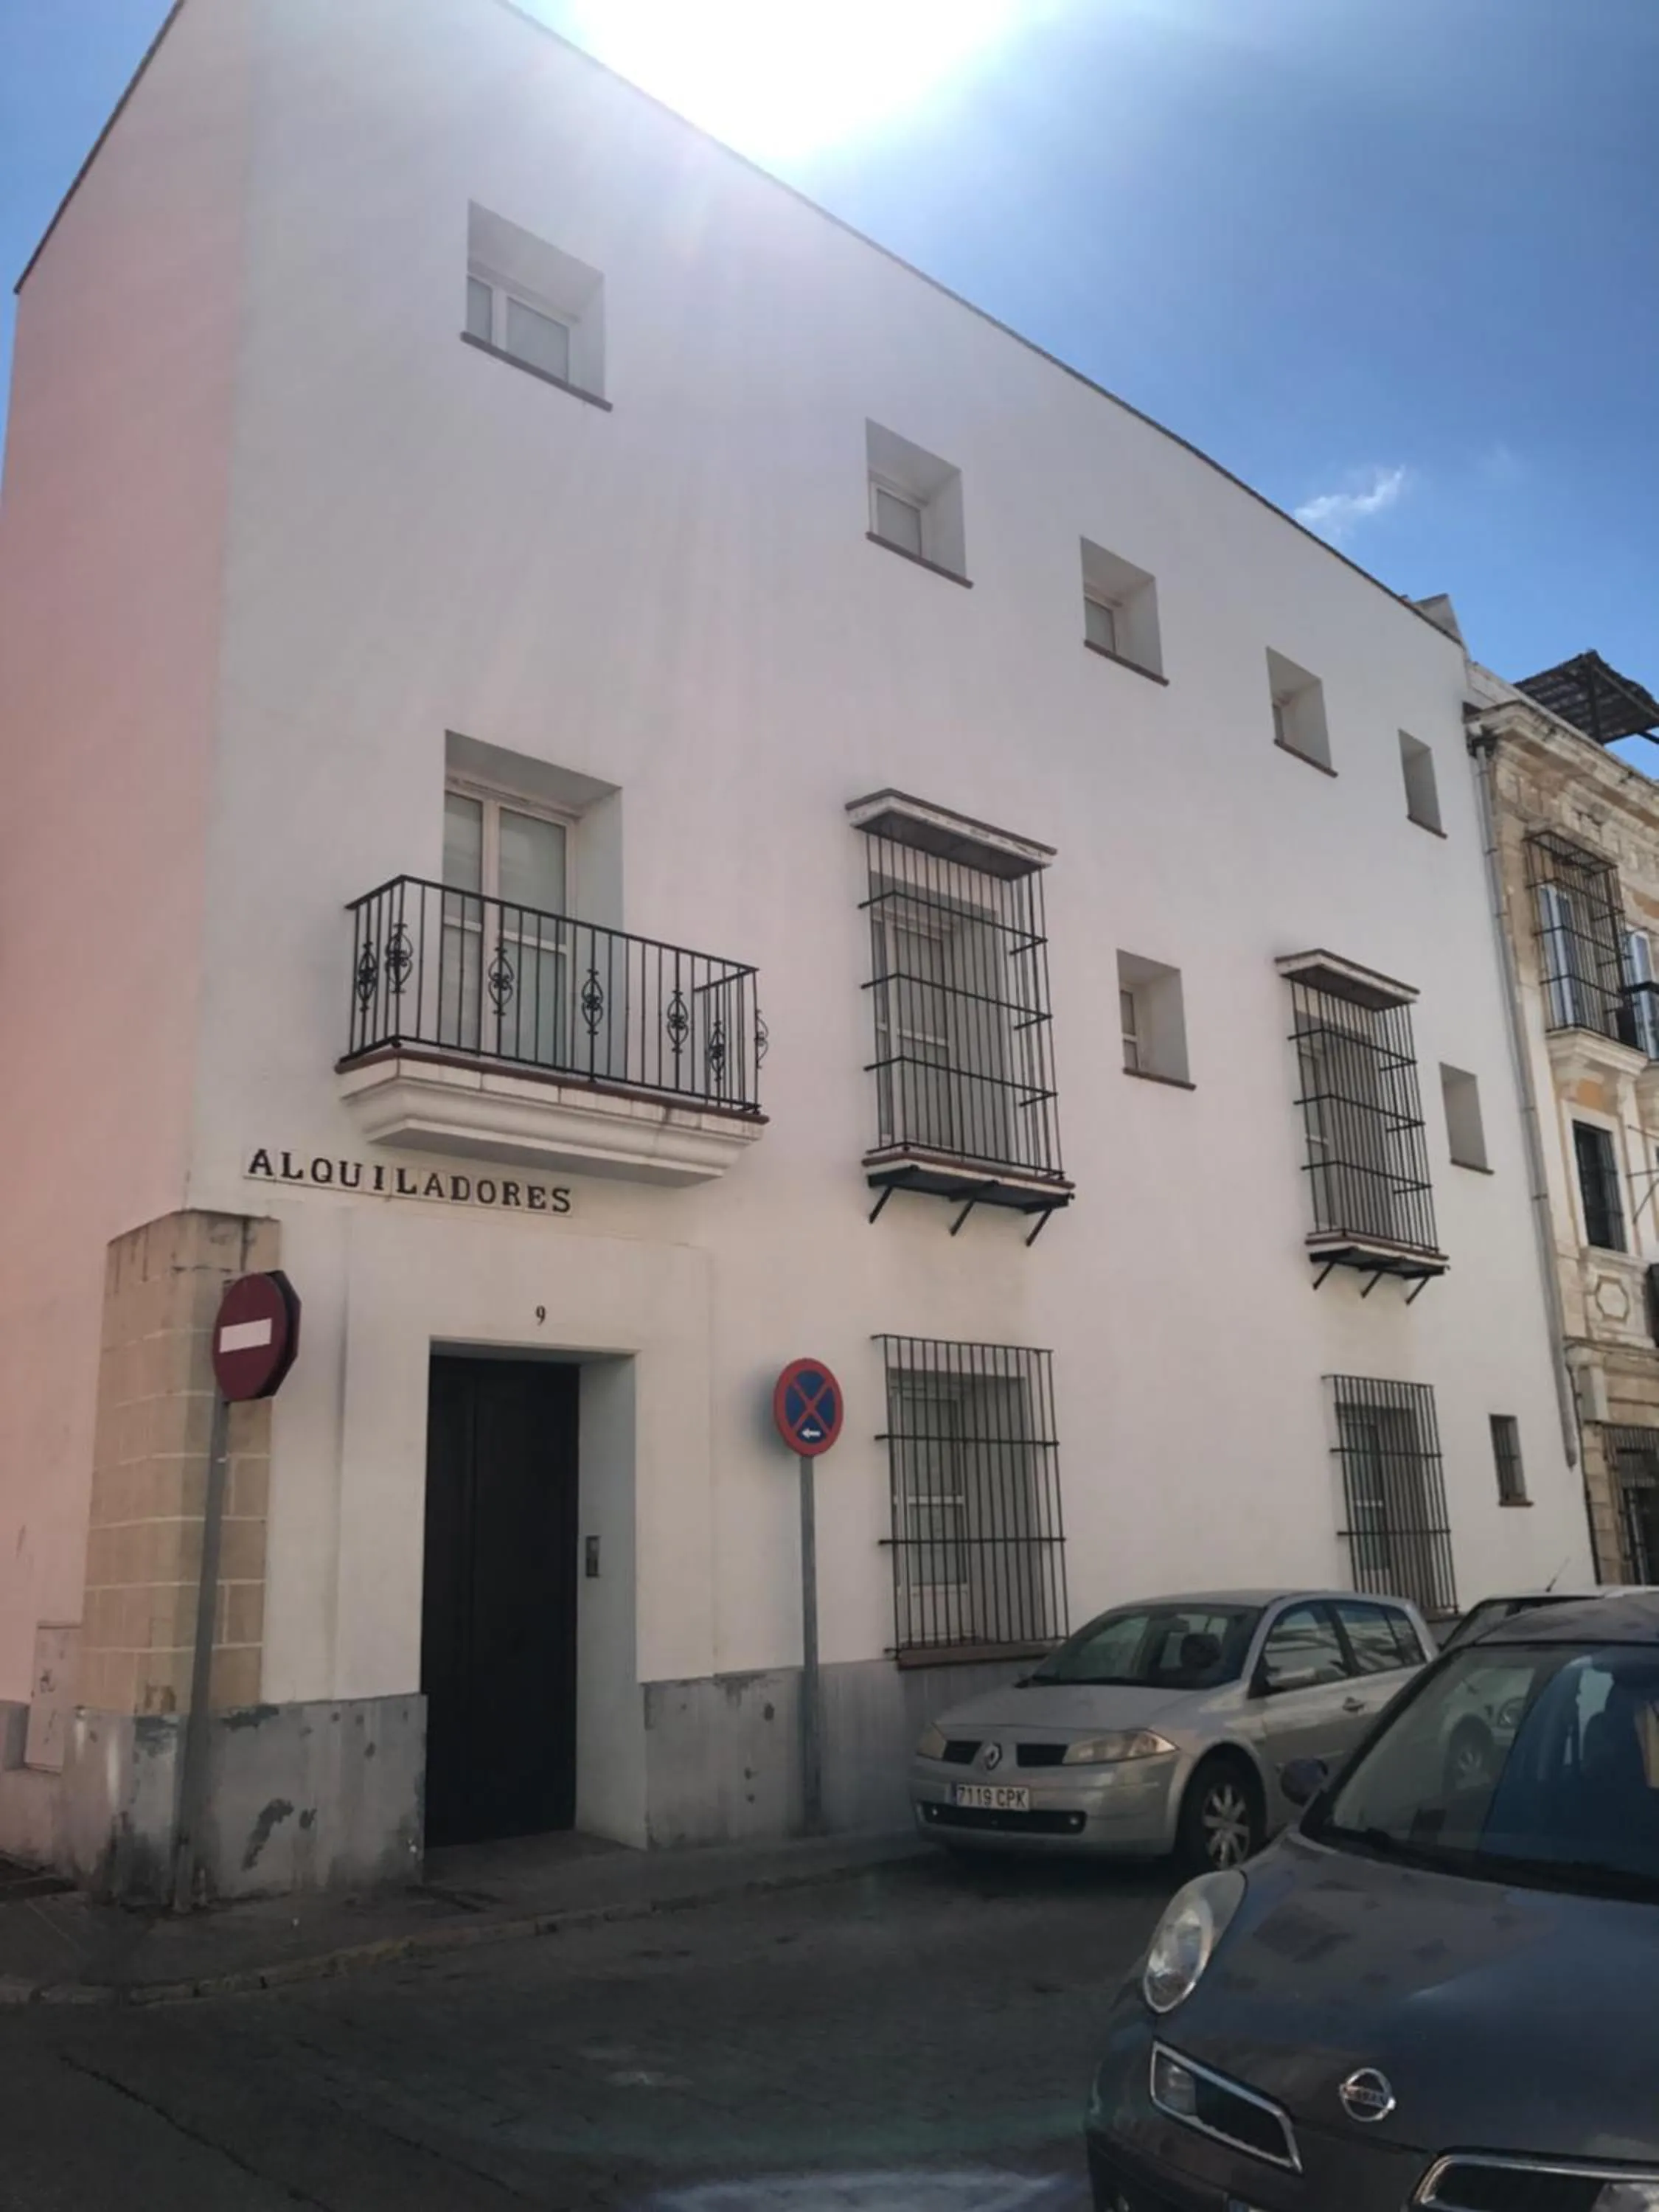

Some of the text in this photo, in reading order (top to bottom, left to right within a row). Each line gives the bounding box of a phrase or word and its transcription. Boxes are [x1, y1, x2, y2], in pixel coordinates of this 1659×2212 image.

[248, 1148, 572, 1214] ALQUILADORES
[535, 1304, 546, 1326] 9
[958, 1786, 1027, 1809] 7119 CPK
